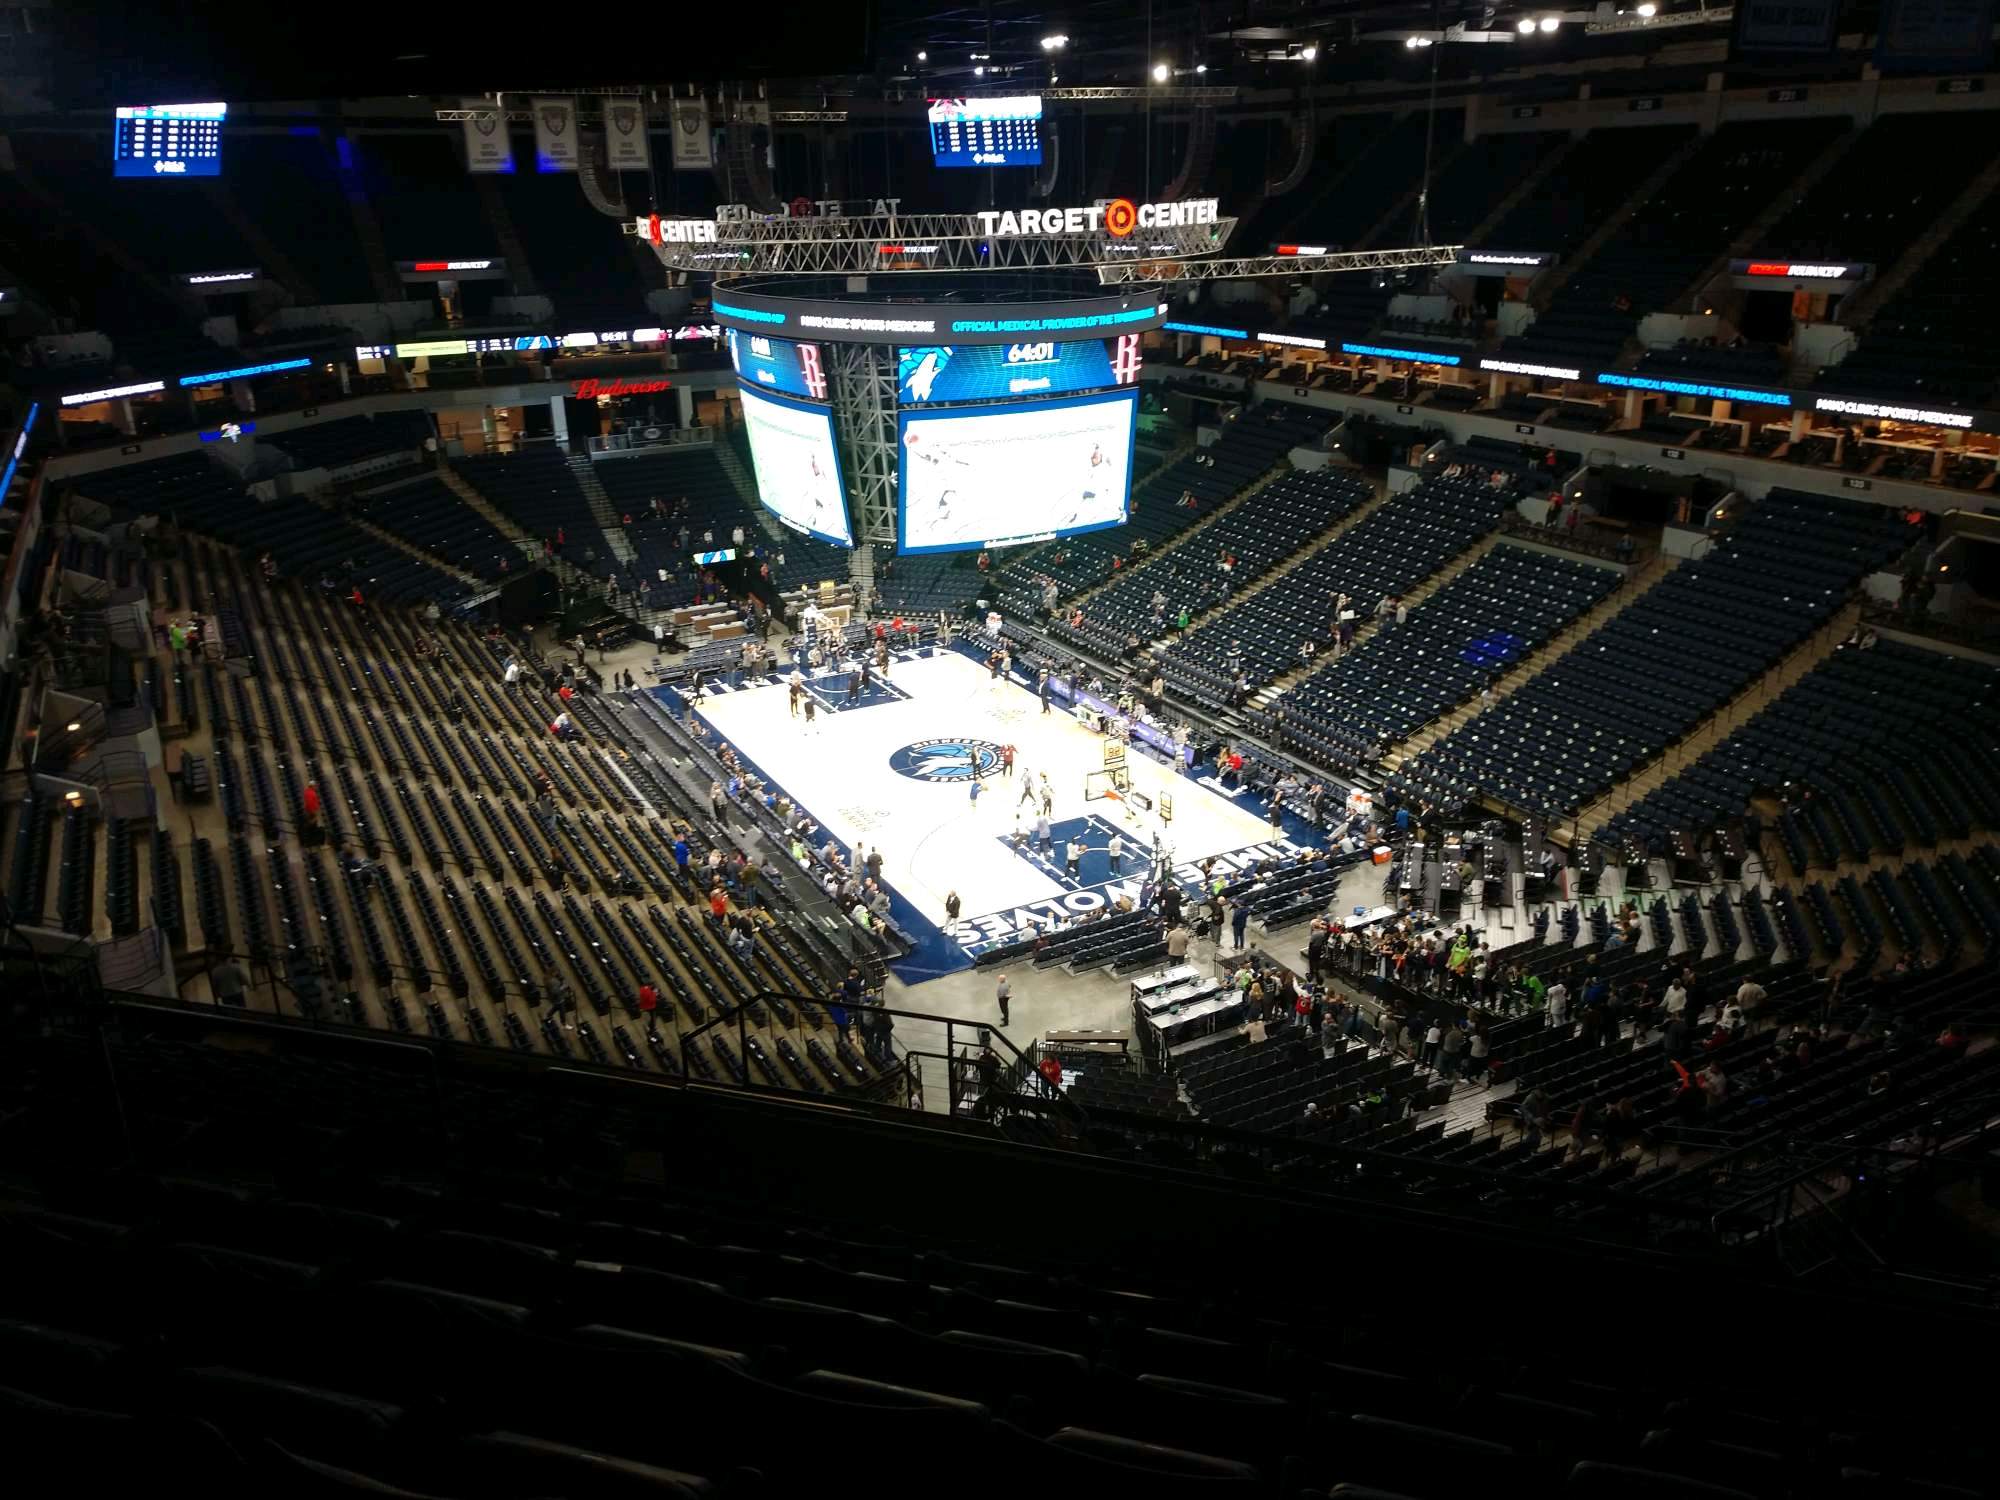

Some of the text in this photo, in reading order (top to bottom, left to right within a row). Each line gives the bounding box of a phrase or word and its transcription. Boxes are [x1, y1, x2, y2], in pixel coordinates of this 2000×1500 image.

[977, 199, 1218, 236] TARGET CENTER
[660, 220, 716, 242] CENTER
[952, 321, 998, 332] OFFICIAL
[998, 319, 1041, 332] MEDICAL
[1041, 316, 1086, 330] PROVIDER
[1008, 342, 1054, 362] 64:01
[572, 378, 672, 399] Budweiser
[1598, 374, 1630, 386] OFFICIAL
[1629, 378, 1661, 390] MEDICAL
[1660, 381, 1699, 395] PROVIDER
[1699, 386, 1710, 395] OF
[1710, 387, 1726, 398] THE
[1816, 398, 1973, 428] MAYO CLINIC SPORTS MEDICINE
